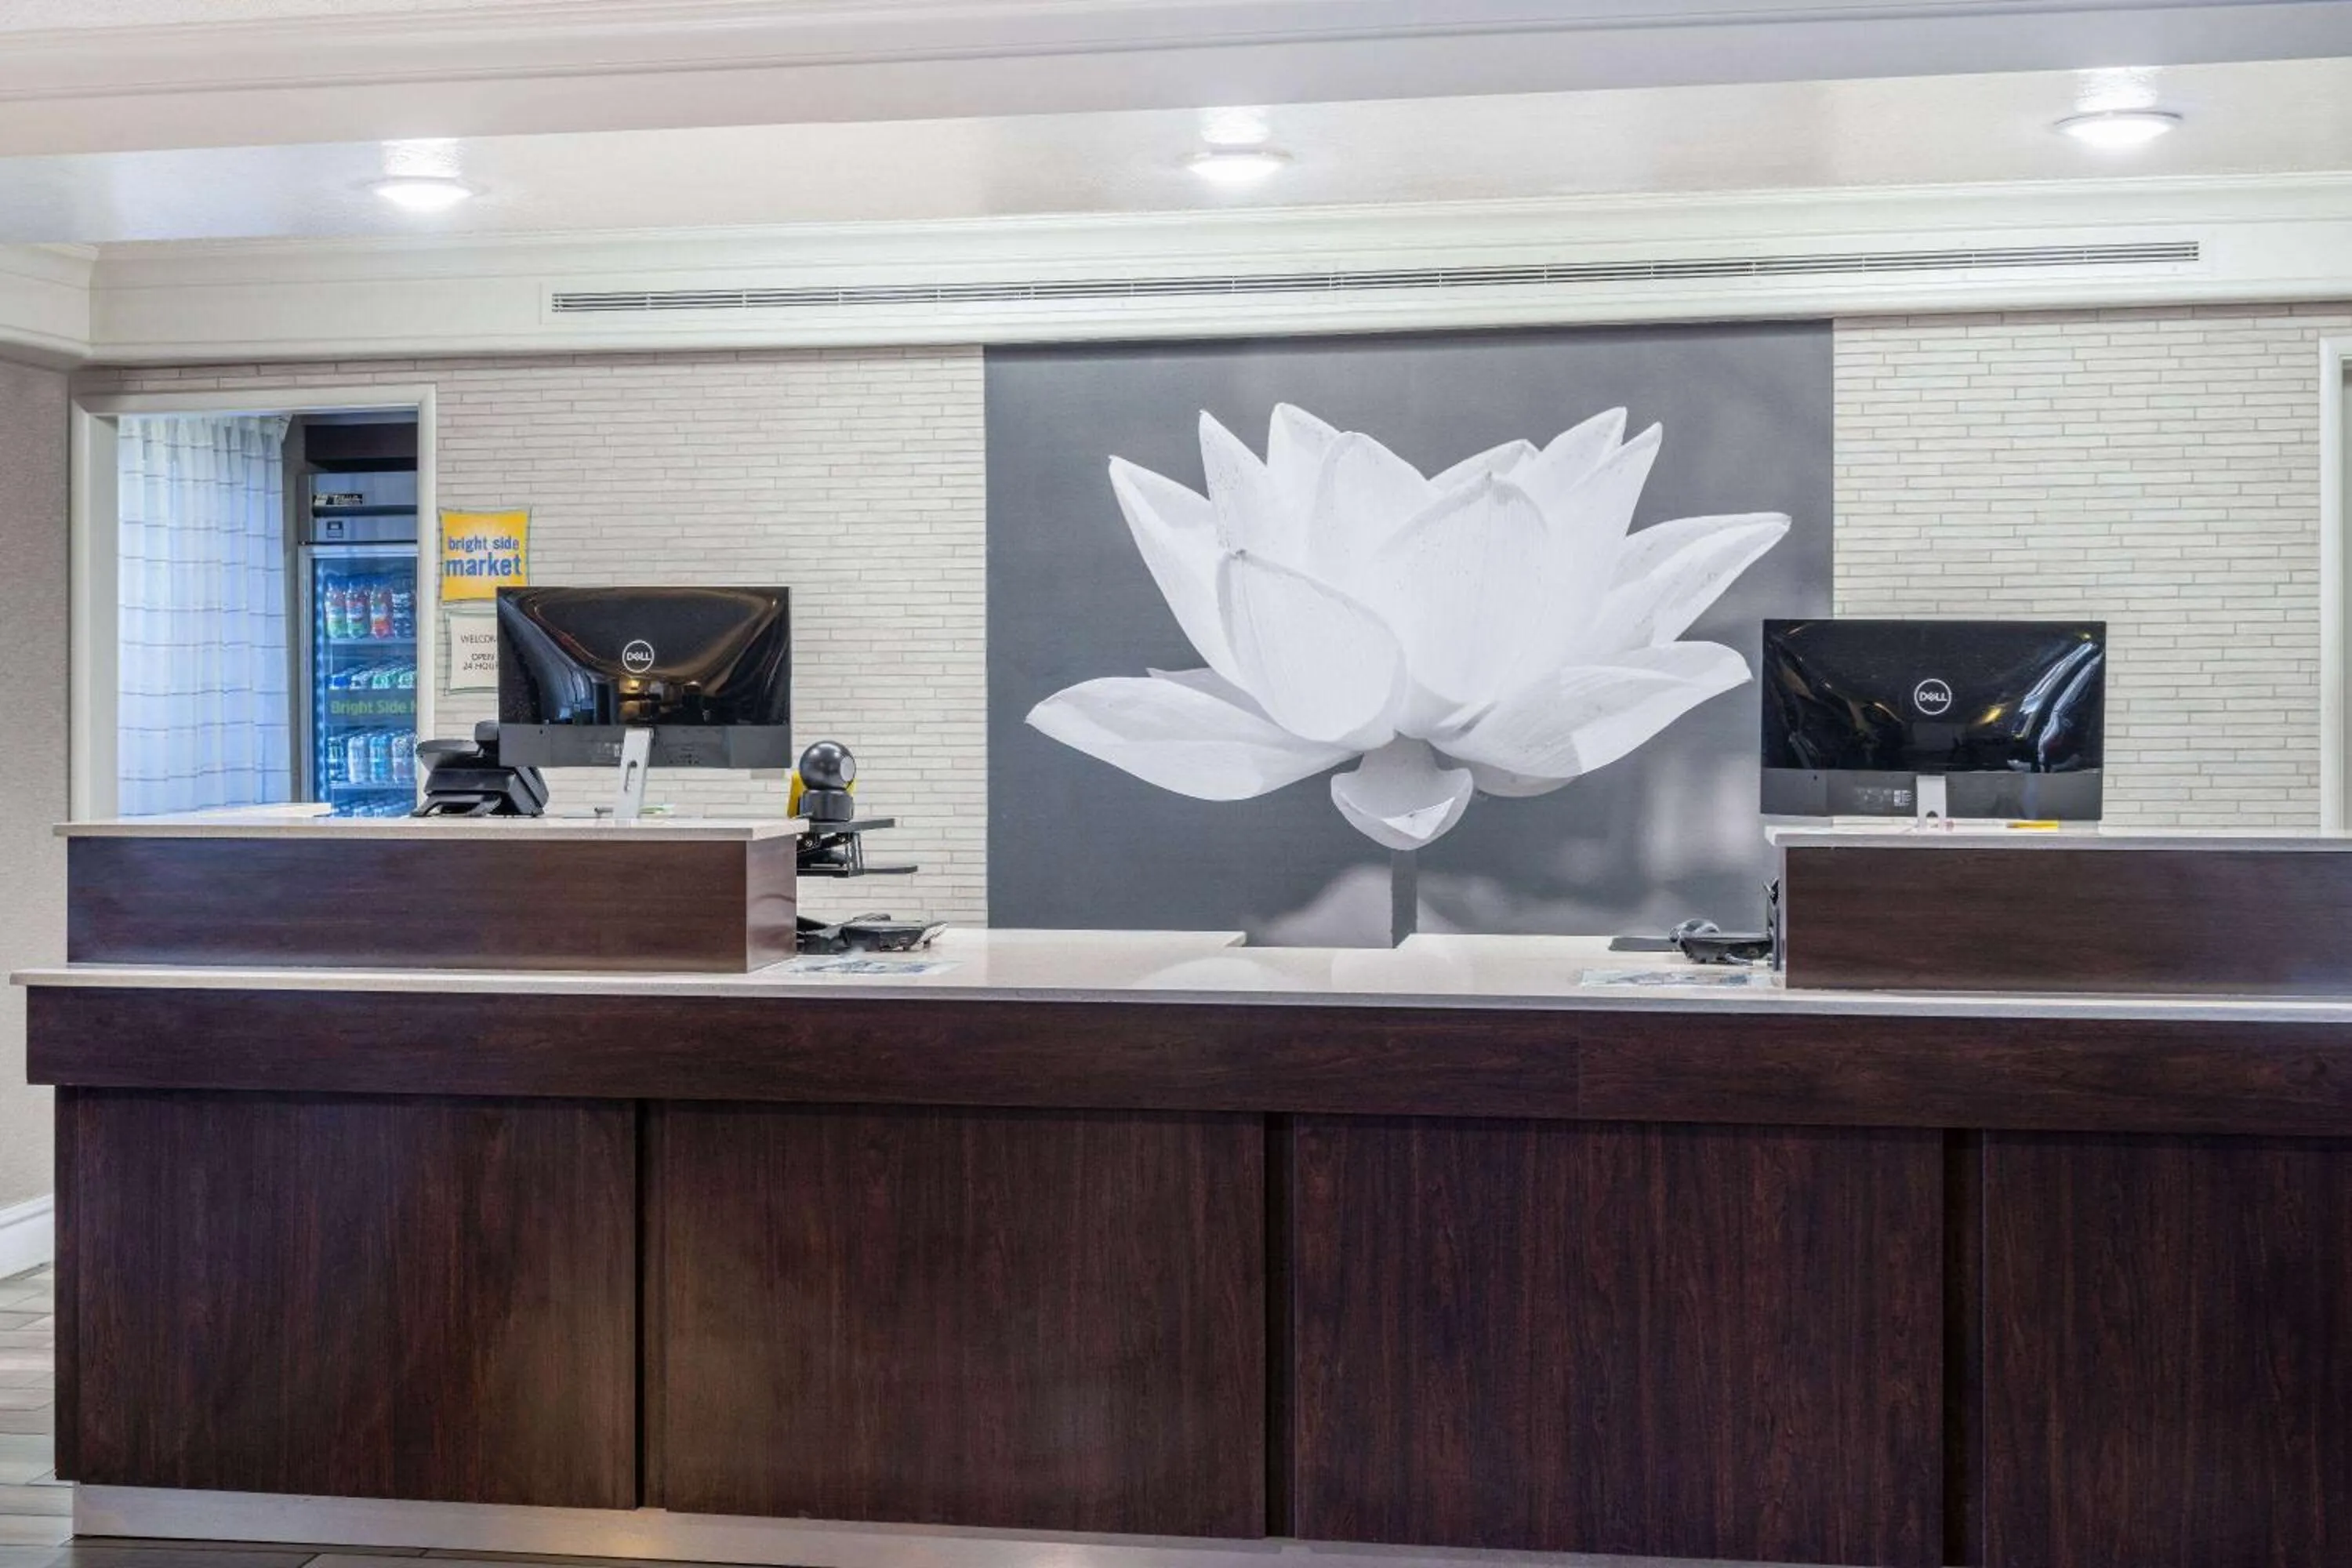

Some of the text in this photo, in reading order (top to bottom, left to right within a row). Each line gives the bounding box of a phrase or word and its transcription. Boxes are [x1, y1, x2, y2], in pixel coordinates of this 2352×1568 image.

[448, 535, 519, 553] bright side
[445, 552, 522, 576] market
[626, 652, 652, 661] DELL
[1918, 691, 1947, 702] DELL
[331, 700, 373, 716] Bright
[376, 699, 407, 714] Side
